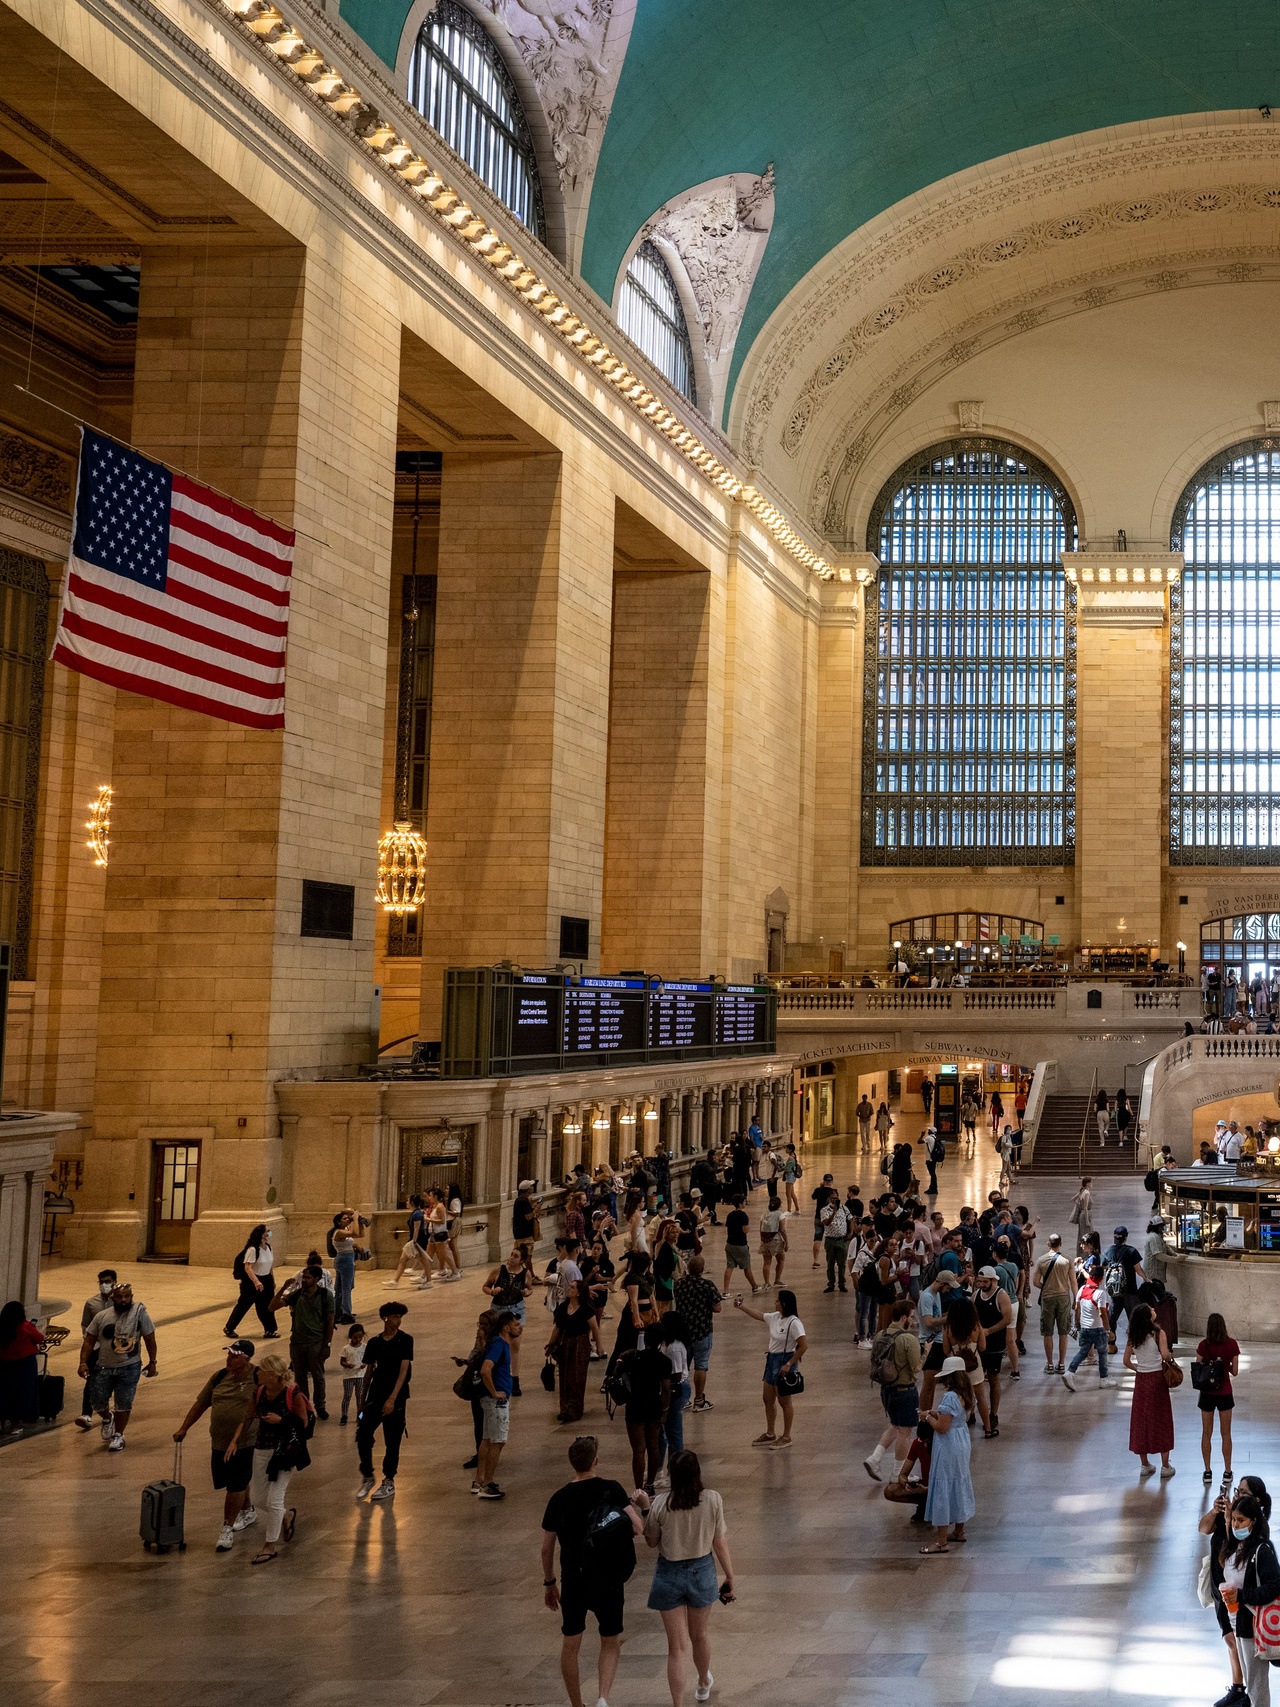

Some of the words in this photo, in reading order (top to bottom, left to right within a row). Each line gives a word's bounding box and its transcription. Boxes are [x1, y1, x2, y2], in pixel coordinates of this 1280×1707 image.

[1209, 908, 1229, 916] THE
[837, 1042, 891, 1053] MACHINES
[925, 1042, 965, 1052] SUBWAY
[973, 1046, 998, 1057] 42ND
[1001, 1051, 1013, 1060] ST
[909, 1055, 943, 1064] SUBWAY
[1196, 1092, 1222, 1104] DINING
[1223, 1084, 1263, 1096] CONCOURSE
